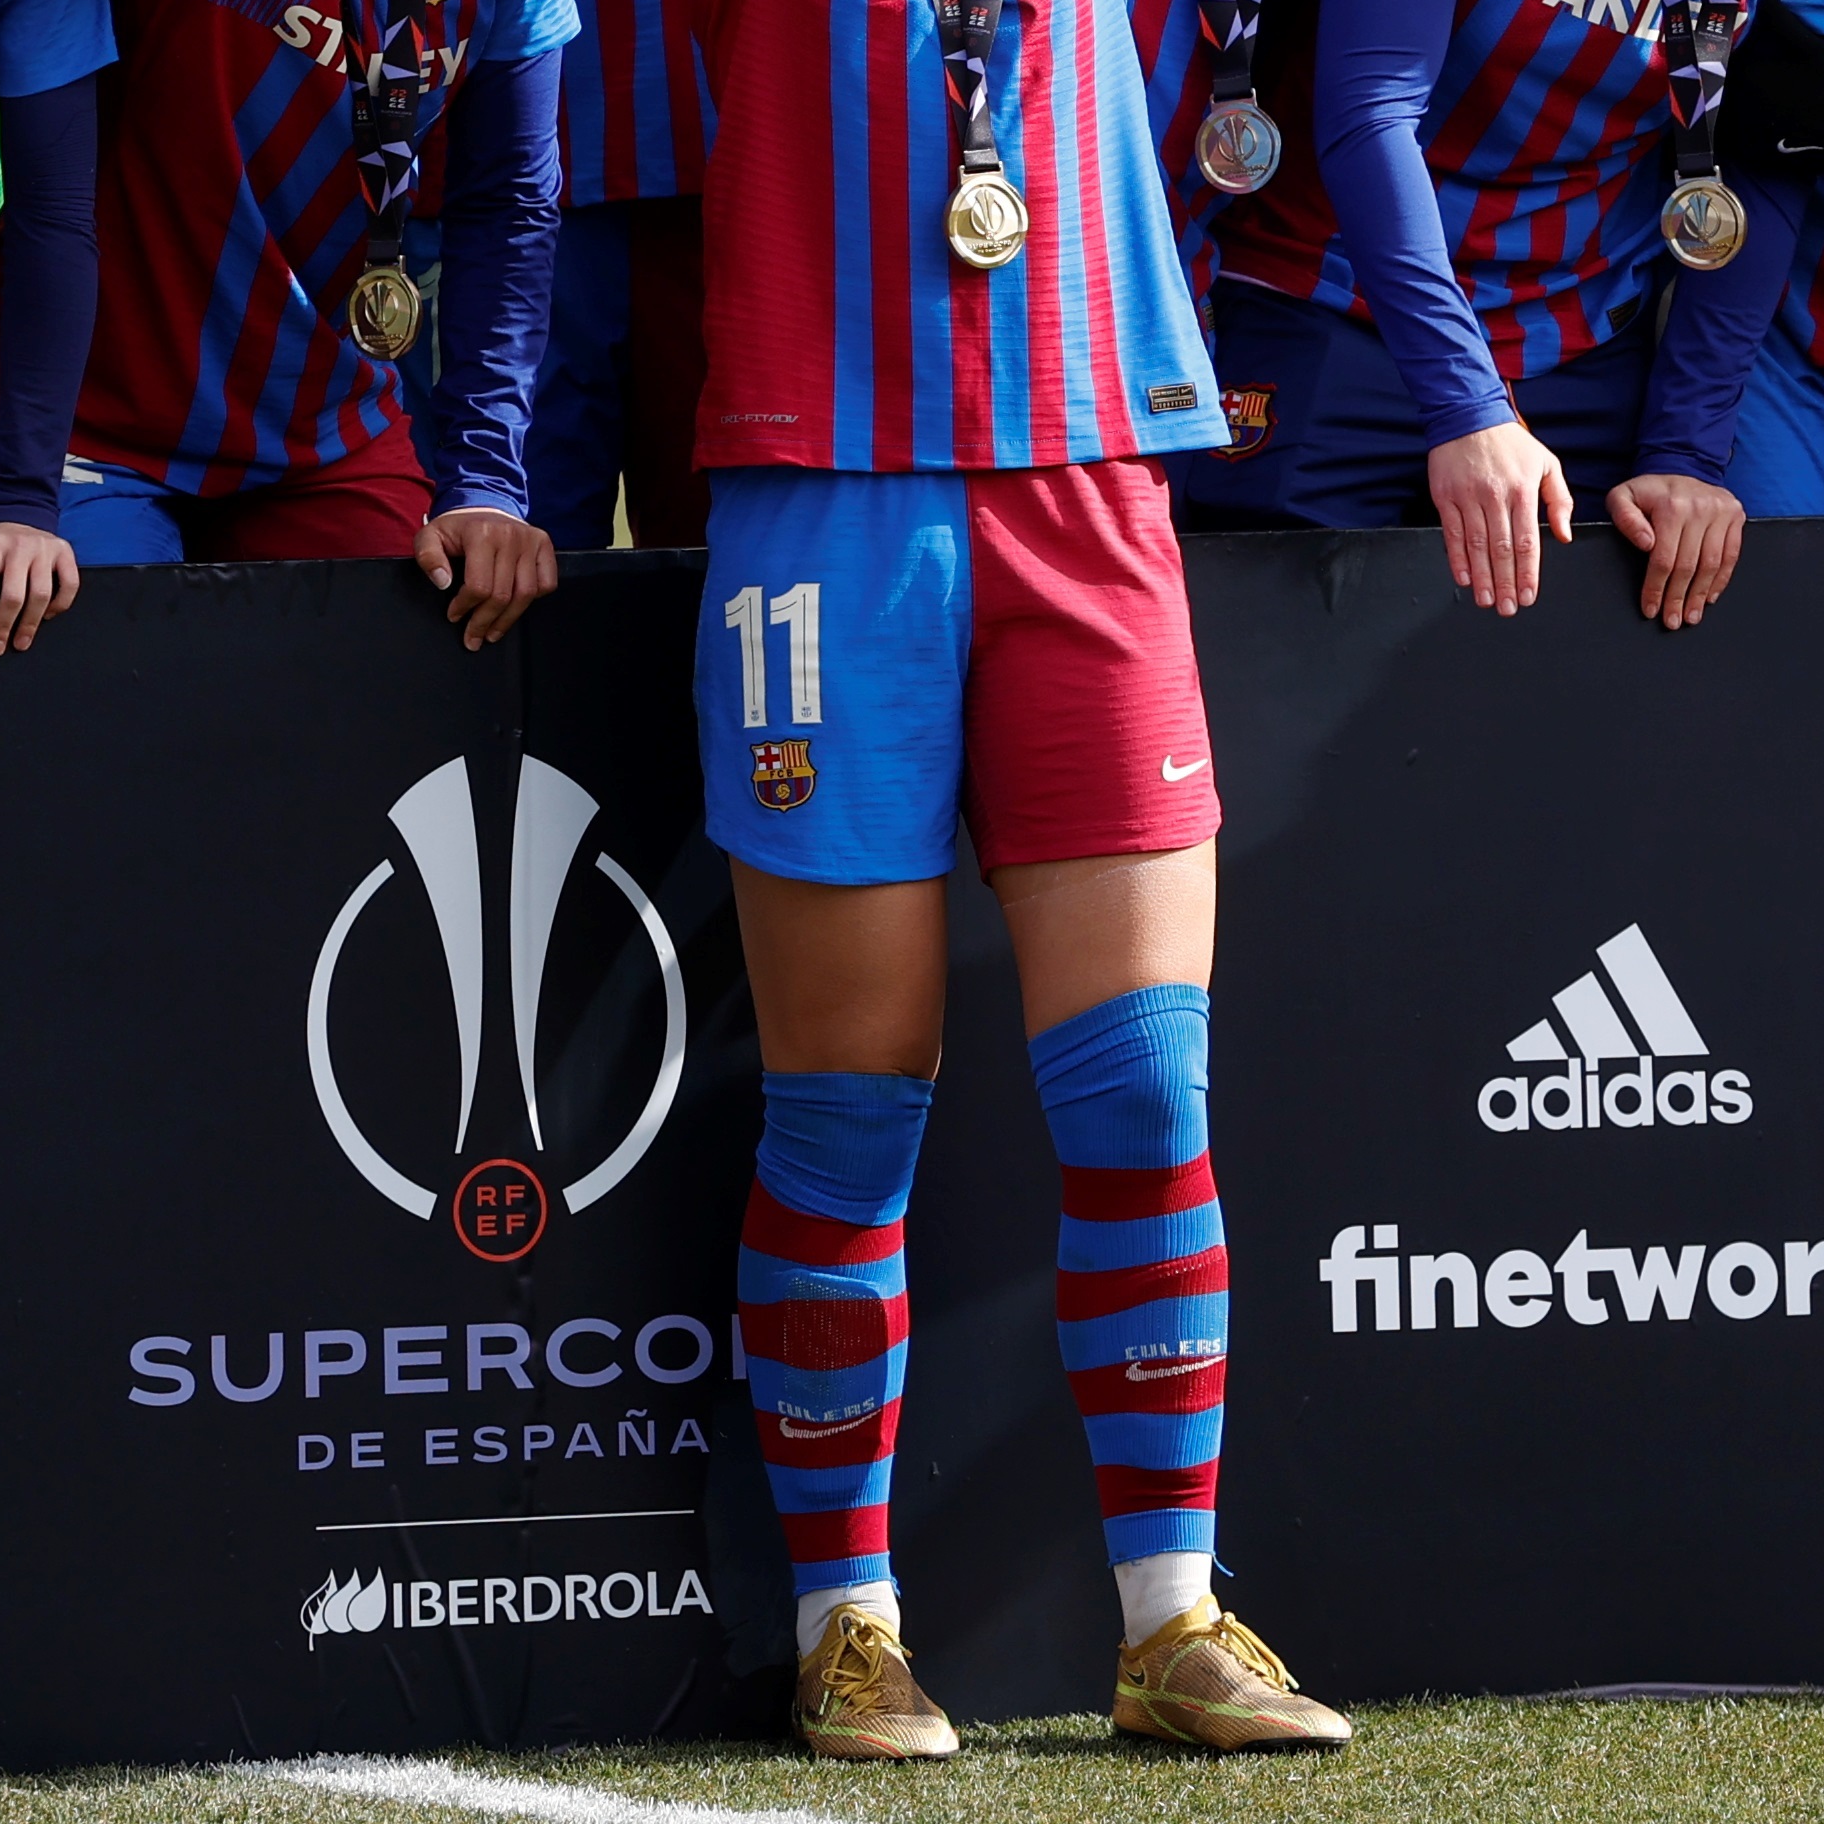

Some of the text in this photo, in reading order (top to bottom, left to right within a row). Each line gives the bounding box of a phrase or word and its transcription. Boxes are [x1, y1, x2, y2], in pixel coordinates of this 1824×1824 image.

[725, 582, 823, 728] 11
[770, 768, 794, 779] FCB
[1478, 1055, 1753, 1133] adidas
[477, 1185, 526, 1207] RF
[477, 1214, 526, 1236] EF
[1125, 1337, 1222, 1360] CULERS
[298, 1410, 709, 1471] DE ESPAÑA
[393, 1570, 713, 1630] IBERDROLA
